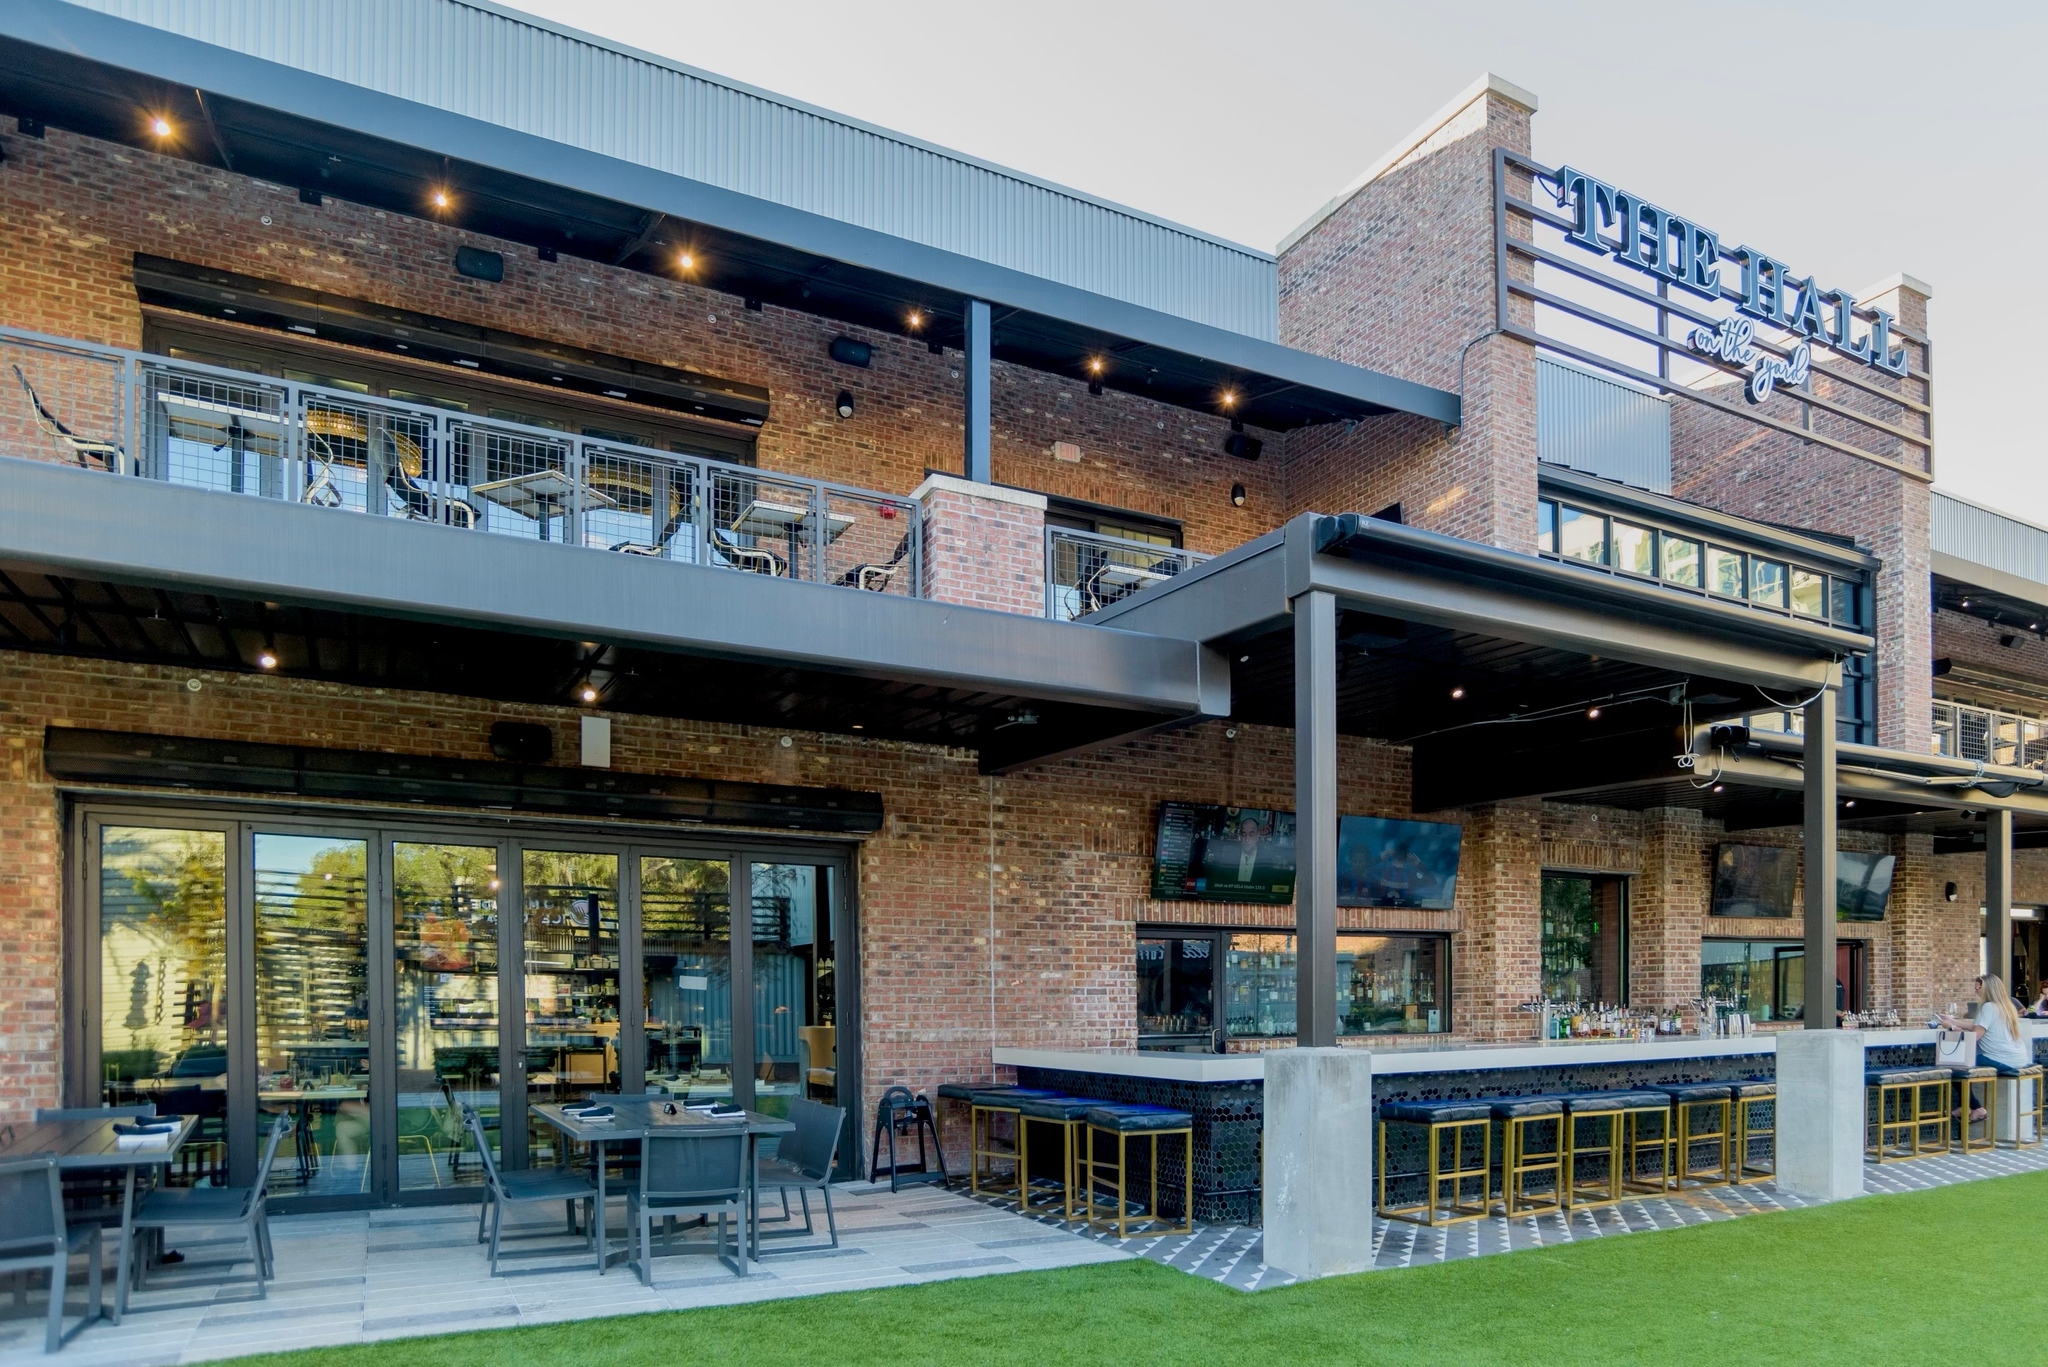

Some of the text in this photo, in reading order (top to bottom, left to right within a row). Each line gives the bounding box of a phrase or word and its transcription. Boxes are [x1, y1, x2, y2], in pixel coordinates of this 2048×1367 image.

[1559, 165, 1908, 378] THE HALL
[1694, 316, 1757, 366] on the
[1751, 342, 1811, 403] yard
